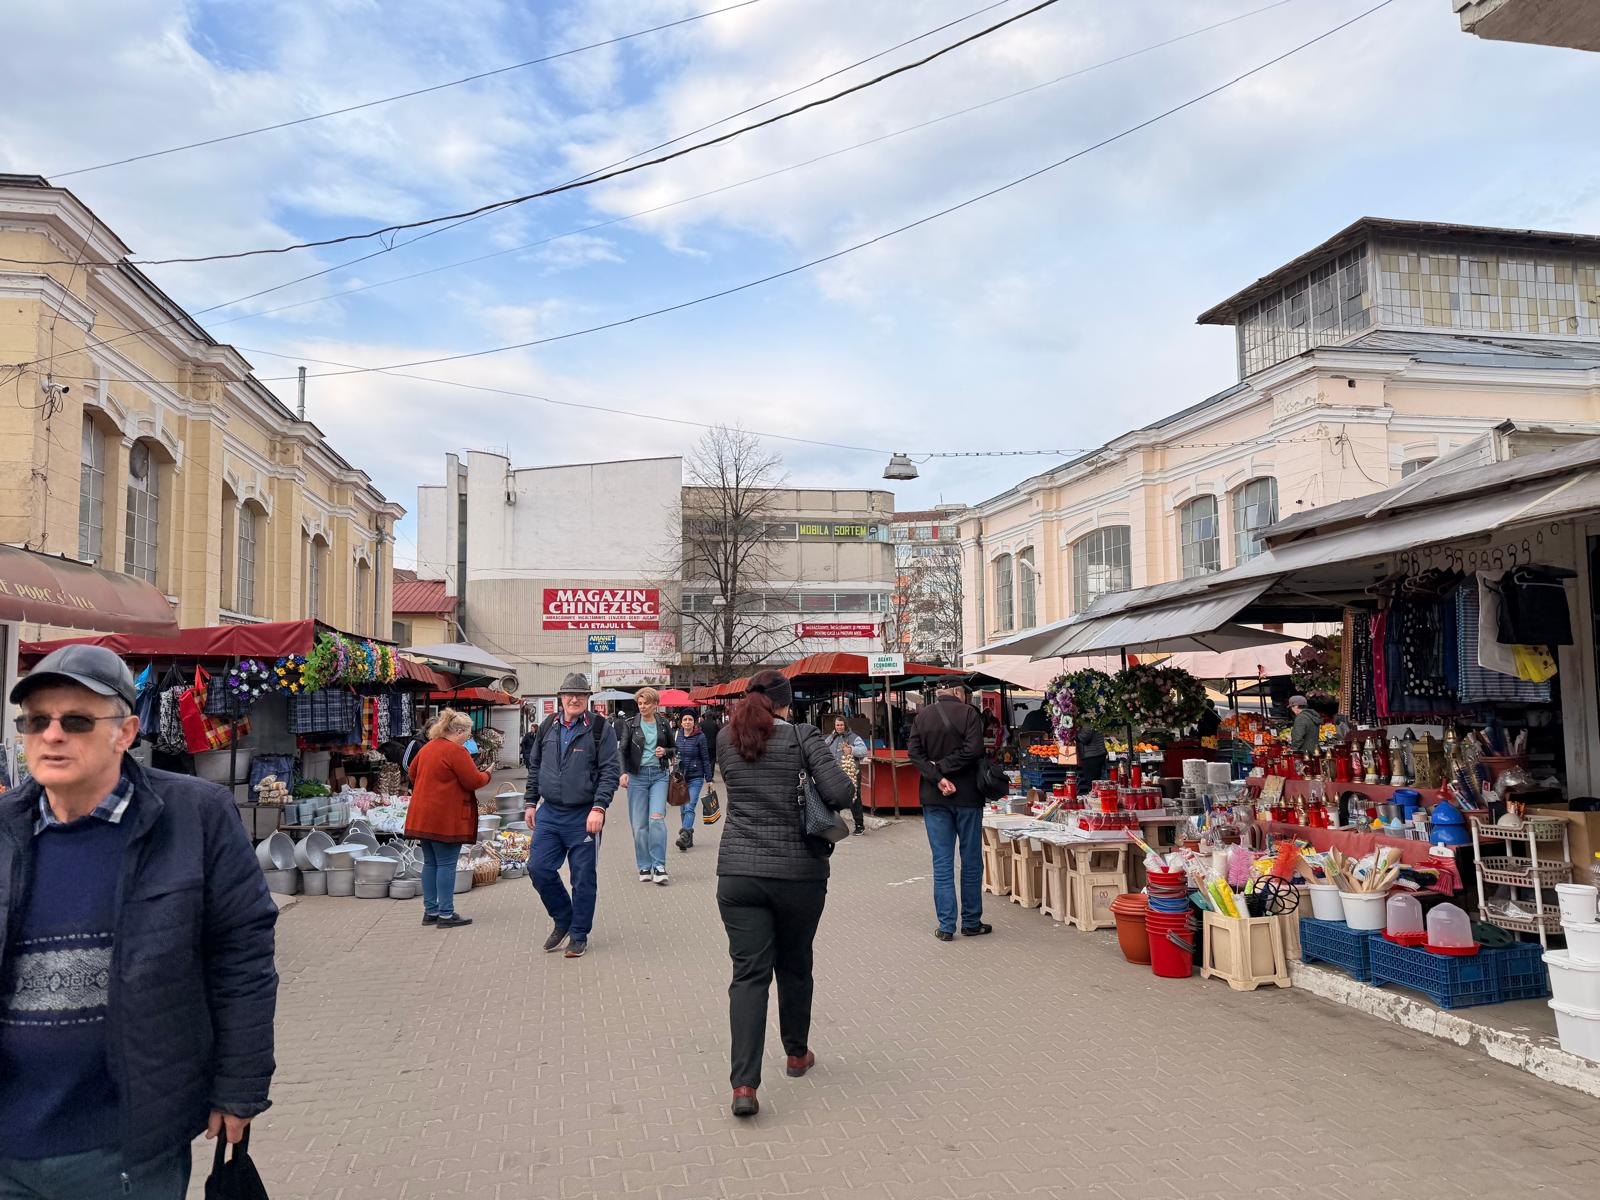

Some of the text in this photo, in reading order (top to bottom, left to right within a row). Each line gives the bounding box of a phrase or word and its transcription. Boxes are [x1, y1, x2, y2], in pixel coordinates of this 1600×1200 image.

[800, 525, 867, 536] MOBILA SORTEM
[14, 583, 55, 603] PORC
[556, 590, 646, 602] MAGAZIN
[548, 602, 654, 614] CHINEZESC
